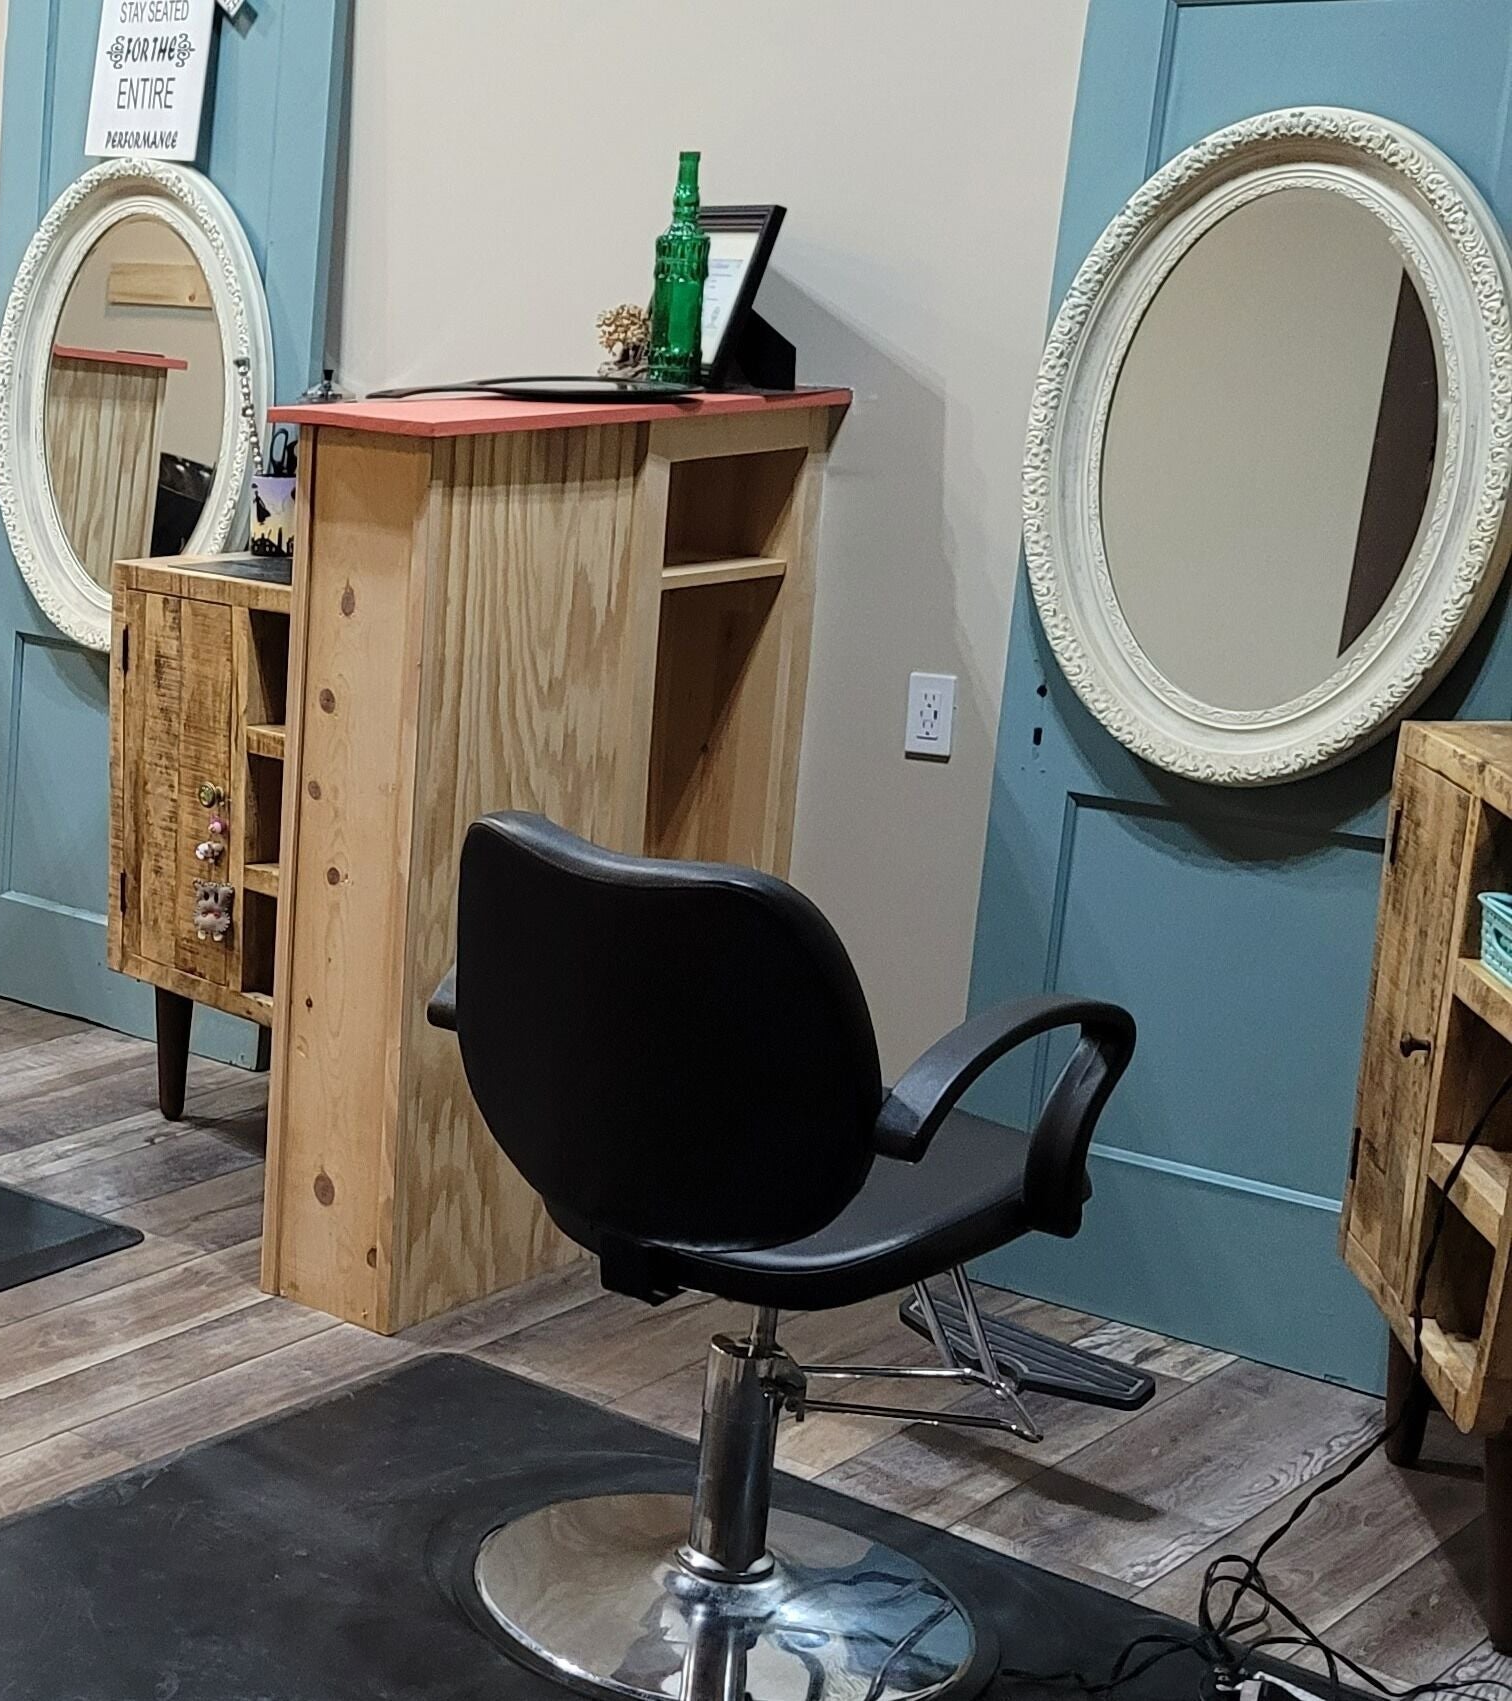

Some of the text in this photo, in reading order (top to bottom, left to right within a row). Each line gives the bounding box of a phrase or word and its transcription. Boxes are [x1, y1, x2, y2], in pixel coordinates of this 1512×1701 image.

[120, 0, 190, 23] STAY SEATED
[125, 36, 177, 62] FOR THE
[117, 77, 176, 109] ENTIRE
[105, 130, 178, 149] PERFORMANCE
